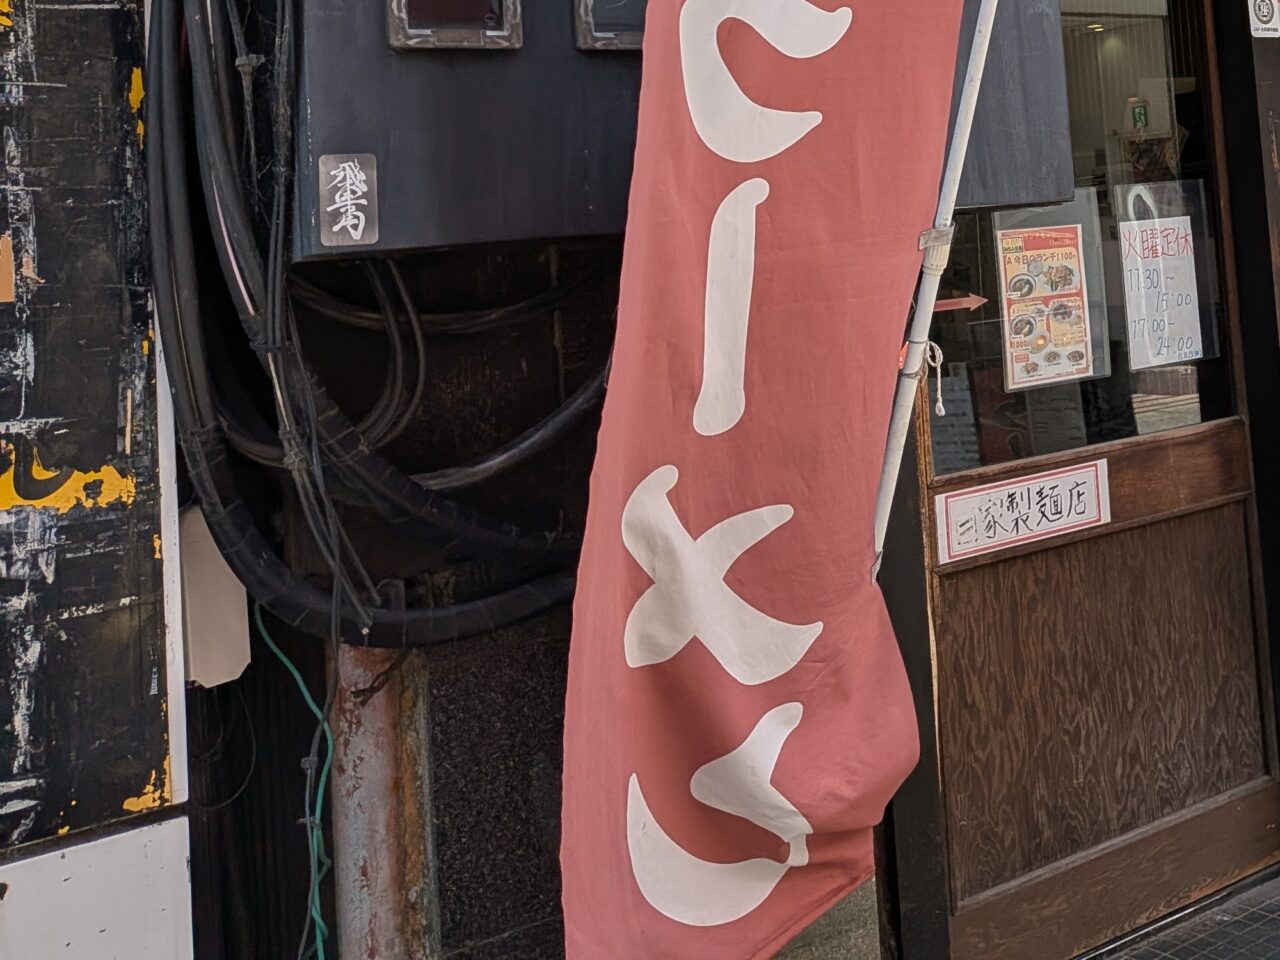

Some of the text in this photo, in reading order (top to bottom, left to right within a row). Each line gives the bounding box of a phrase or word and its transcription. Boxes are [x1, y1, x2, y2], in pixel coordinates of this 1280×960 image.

[1123, 227, 1194, 261] 火曜定休
[1156, 291, 1192, 313] 15:00
[1157, 336, 1194, 357] 24:00
